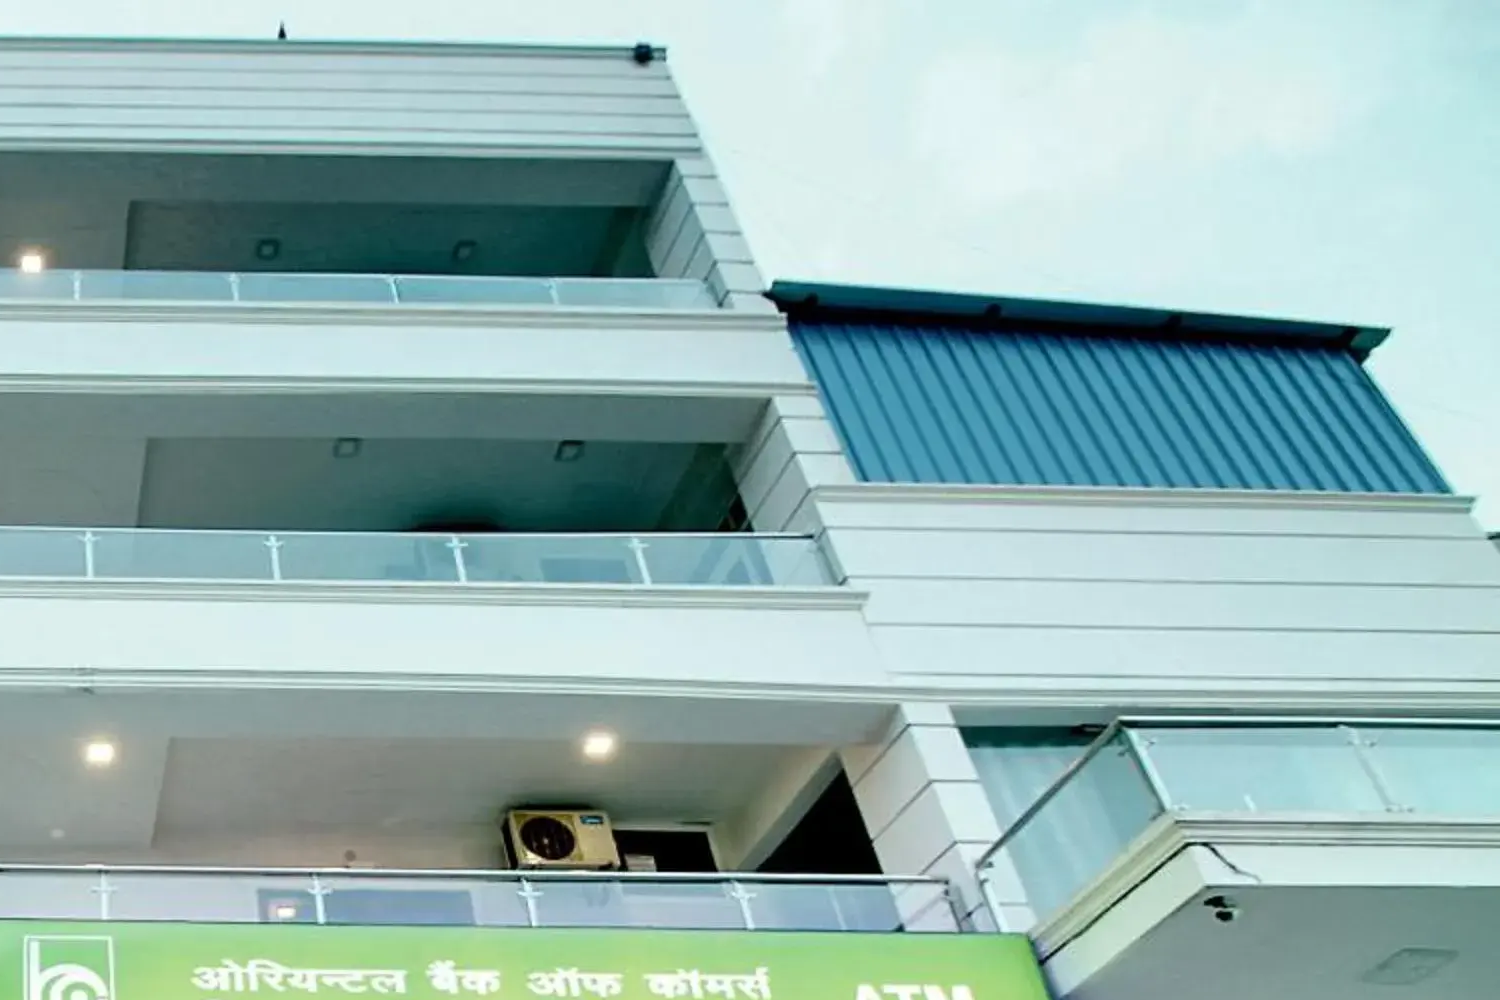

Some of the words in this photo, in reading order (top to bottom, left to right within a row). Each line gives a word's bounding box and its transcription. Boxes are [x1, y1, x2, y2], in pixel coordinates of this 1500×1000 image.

[191, 958, 408, 995] ओरियन्टल
[426, 959, 500, 995] बैंक
[527, 965, 623, 999] ऑफ
[644, 965, 772, 1000] कॉमर्स
